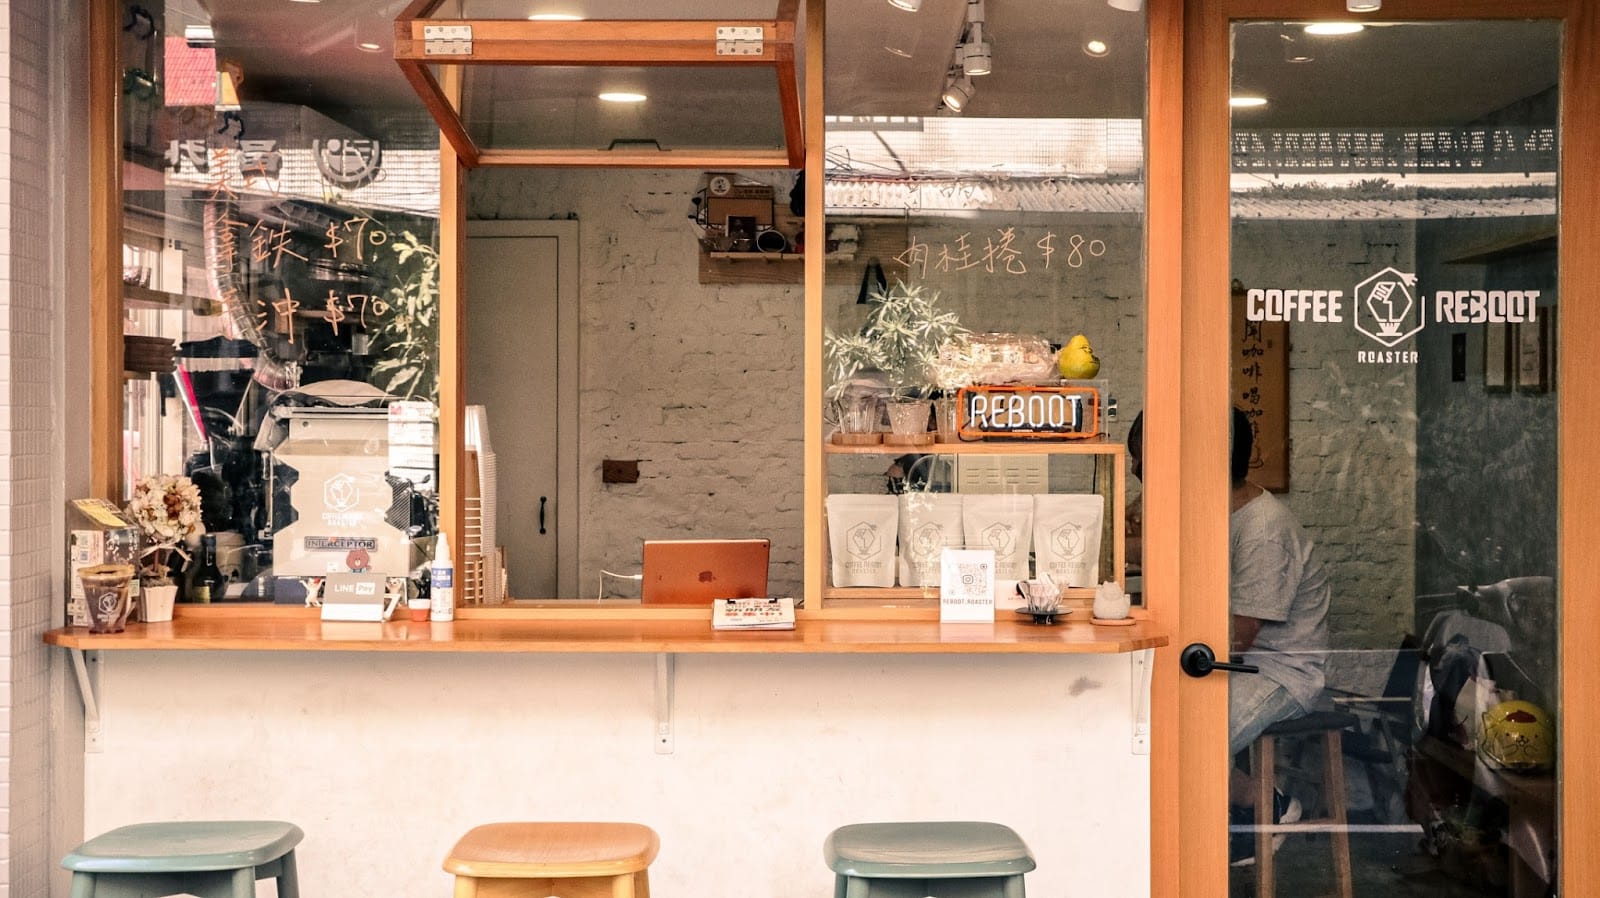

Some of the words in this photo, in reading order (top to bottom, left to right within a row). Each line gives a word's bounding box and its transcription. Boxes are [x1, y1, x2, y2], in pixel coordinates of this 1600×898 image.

[324, 217, 387, 261] $70
[1036, 231, 1106, 270] $80
[323, 289, 389, 337] $70
[1246, 288, 1344, 323] COFFEE
[1435, 290, 1541, 324] REBOOT
[1357, 350, 1419, 364] ROASTER
[970, 394, 1082, 428] REBOOT
[307, 539, 374, 549] INTERCEPTOR
[334, 583, 354, 593] LINE
[357, 583, 375, 594] Pay
